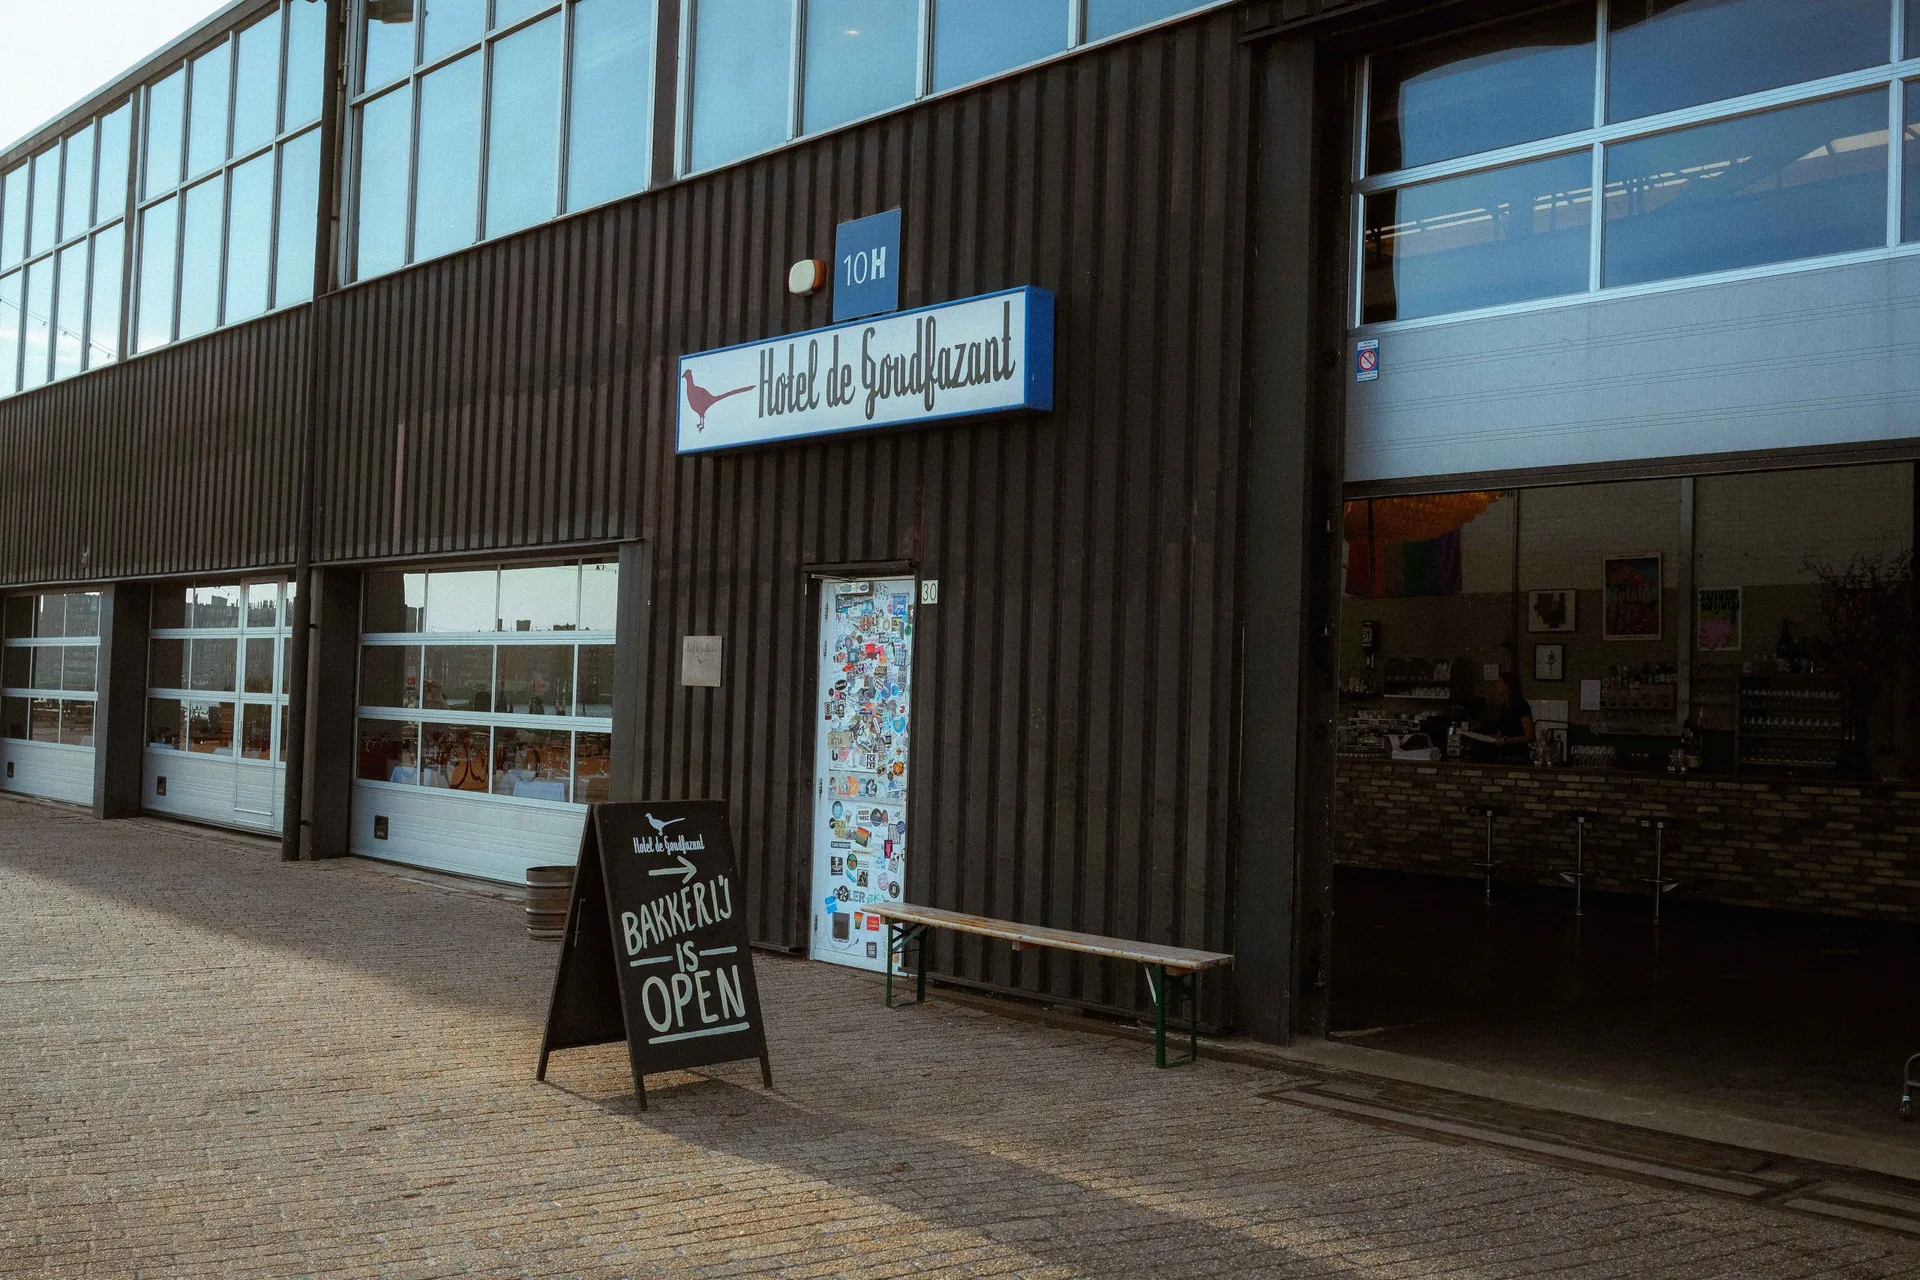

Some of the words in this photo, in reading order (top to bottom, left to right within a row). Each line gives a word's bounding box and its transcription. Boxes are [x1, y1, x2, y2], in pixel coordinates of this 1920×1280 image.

[758, 338, 820, 418] Hotel
[826, 334, 856, 408] de
[861, 300, 1016, 421] Goudfazant
[922, 582, 937, 602] 30
[632, 836, 655, 854] Hotel
[654, 835, 665, 853] de
[663, 833, 705, 856] Goudfazant
[621, 874, 733, 956] BAKKERIJ
[675, 940, 699, 973] IS
[641, 964, 746, 1033] OPEN
